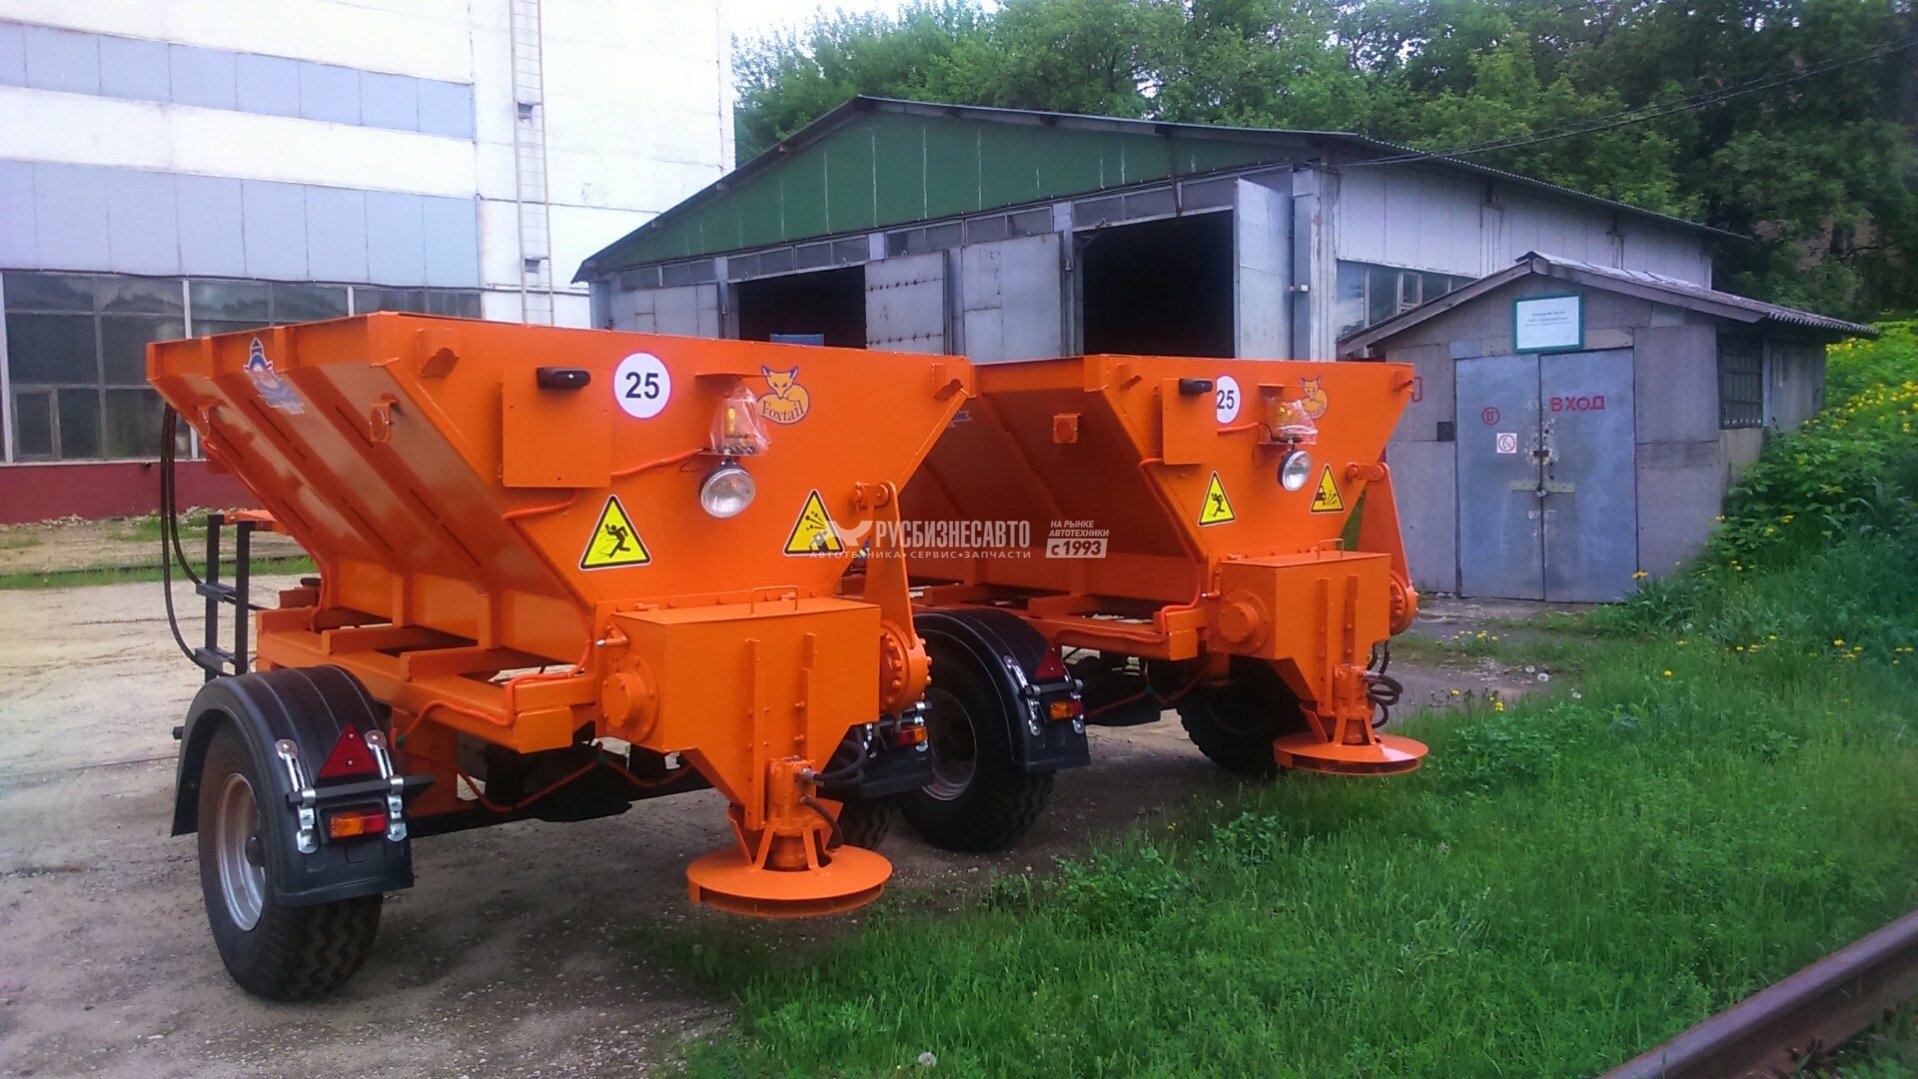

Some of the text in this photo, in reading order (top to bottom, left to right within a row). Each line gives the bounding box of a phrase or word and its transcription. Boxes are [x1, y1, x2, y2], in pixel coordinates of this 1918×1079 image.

[625, 371, 661, 400] 25
[762, 399, 805, 422] Foxtail
[1217, 389, 1235, 410] 25
[1551, 395, 1606, 412] ВХОД
